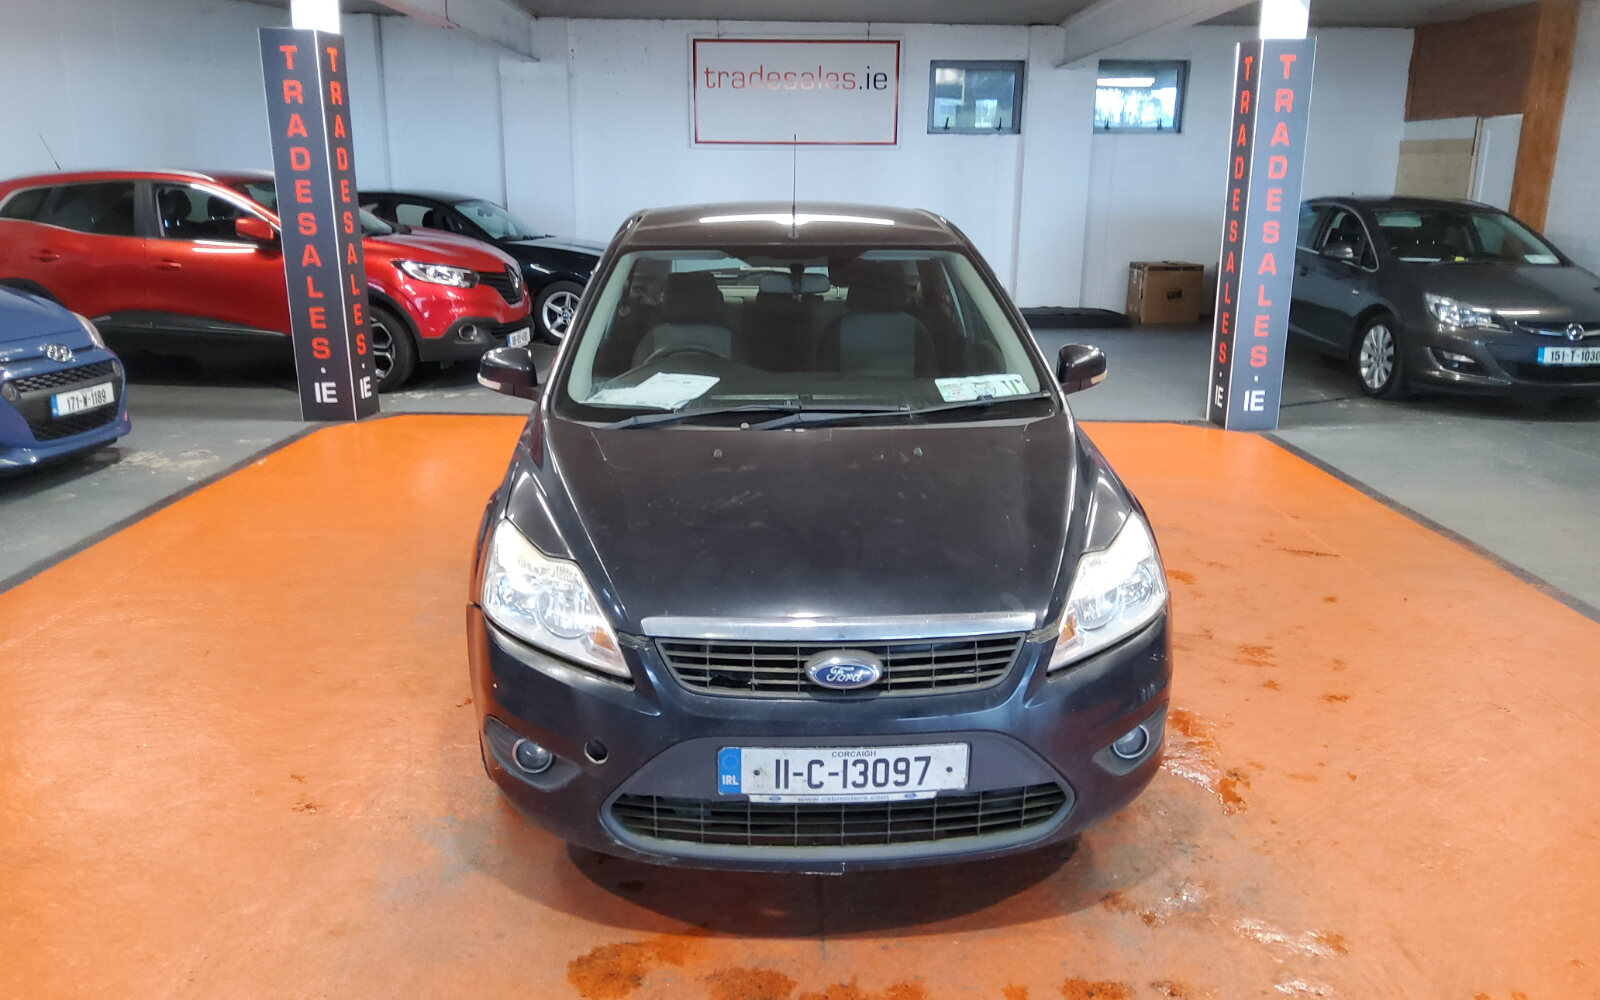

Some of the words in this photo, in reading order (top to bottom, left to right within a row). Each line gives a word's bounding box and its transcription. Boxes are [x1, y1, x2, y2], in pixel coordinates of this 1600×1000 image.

[704, 64, 888, 90] tradesales.ie
[826, 666, 863, 682] Ford
[831, 750, 877, 758] CORCAIGH
[722, 774, 740, 786] IRL
[775, 756, 932, 789] 11-C-13097
